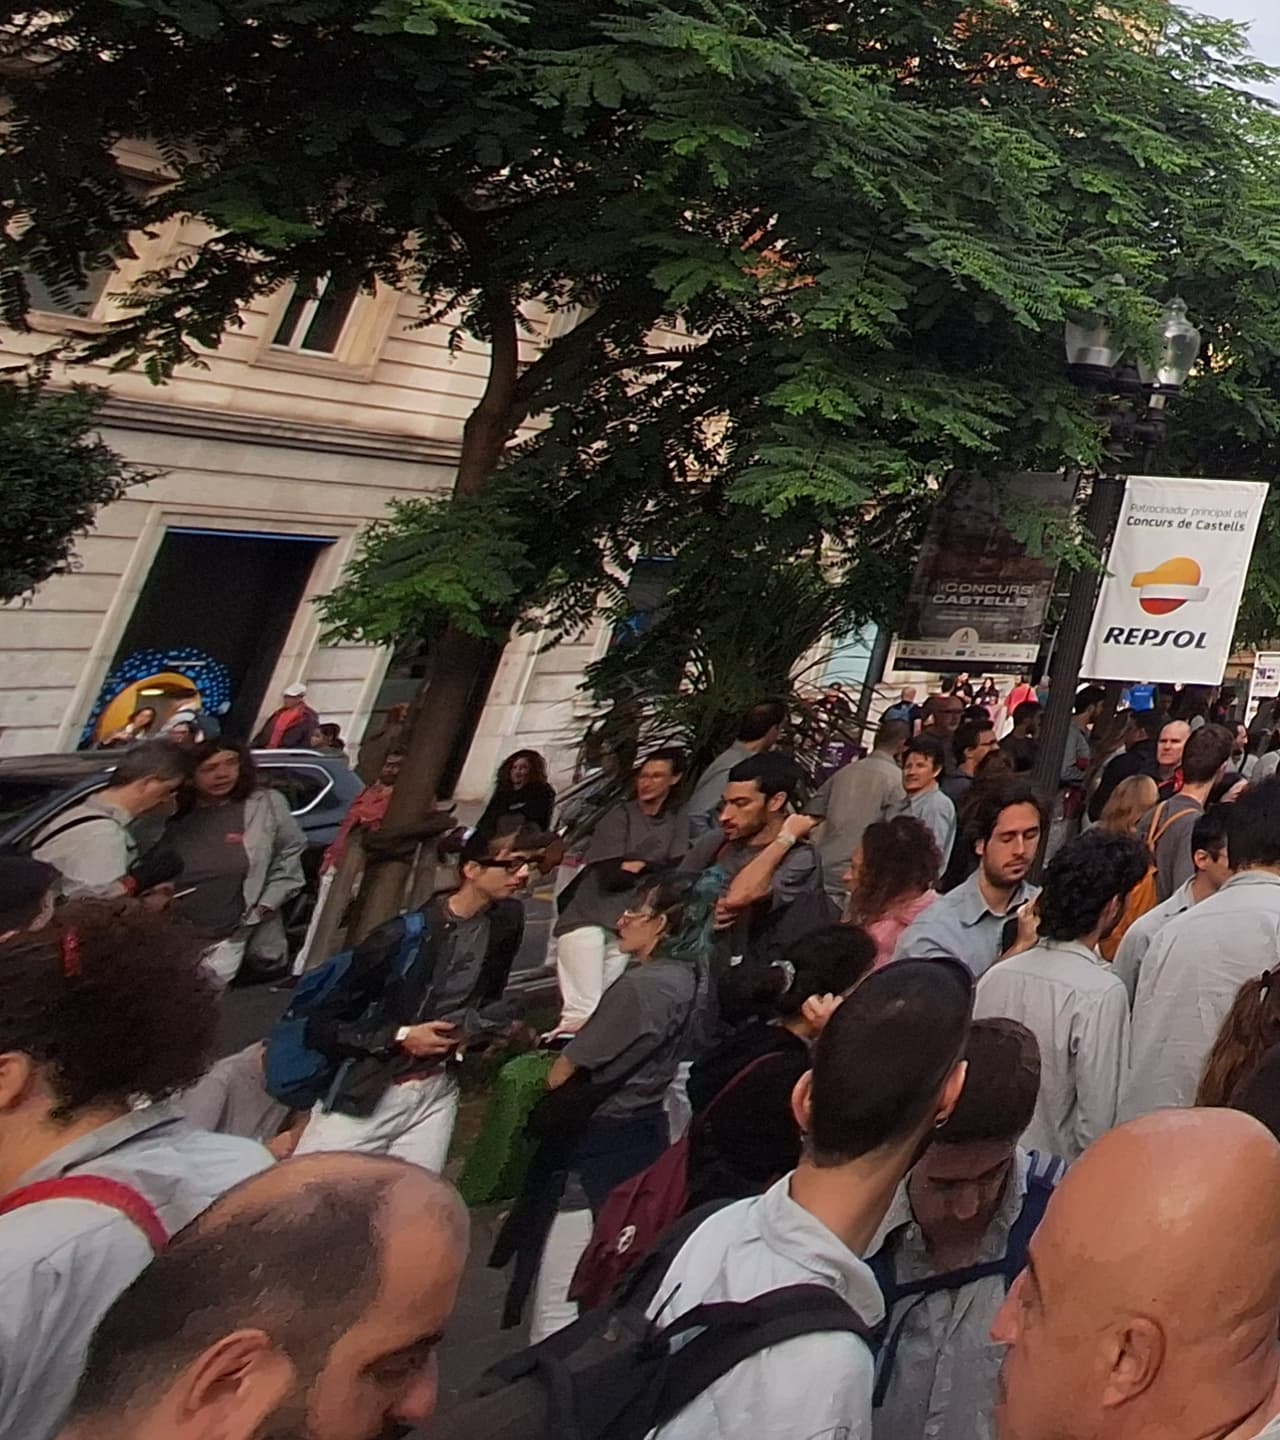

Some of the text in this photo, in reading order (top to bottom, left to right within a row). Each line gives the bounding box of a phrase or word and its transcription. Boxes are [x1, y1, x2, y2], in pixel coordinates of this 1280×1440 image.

[1130, 503, 1248, 519] Patrocinador principal del
[1126, 516, 1246, 532] Concurs de Castells
[944, 583, 1034, 595] CONCURS
[932, 594, 1028, 606] CASTELLS
[1103, 627, 1208, 649] REPSOL
